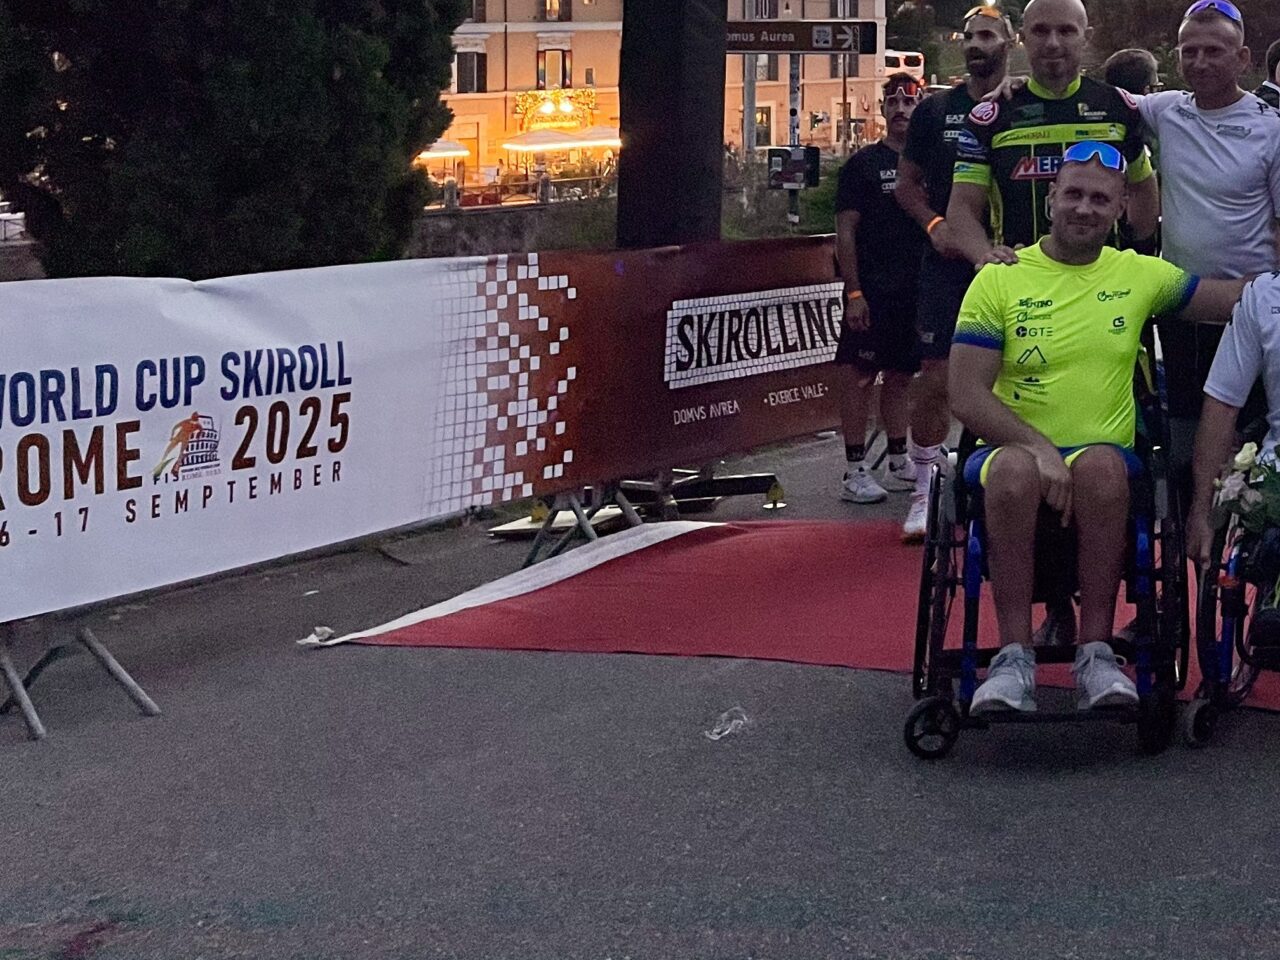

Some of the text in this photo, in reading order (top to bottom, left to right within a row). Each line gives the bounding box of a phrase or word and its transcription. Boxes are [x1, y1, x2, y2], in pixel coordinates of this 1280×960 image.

[726, 30, 795, 42] omus Aurea
[945, 114, 965, 122] EA7
[675, 296, 842, 372] SKIROLLING
[1028, 326, 1054, 337] GTE
[0, 340, 353, 429] ORLD CUP SKIROLL
[768, 382, 825, 406] EXERCE VALE
[673, 399, 741, 425] DOMVS AVREA
[0, 391, 352, 511] OME 2025
[125, 460, 342, 523] SEMPTEMBER
